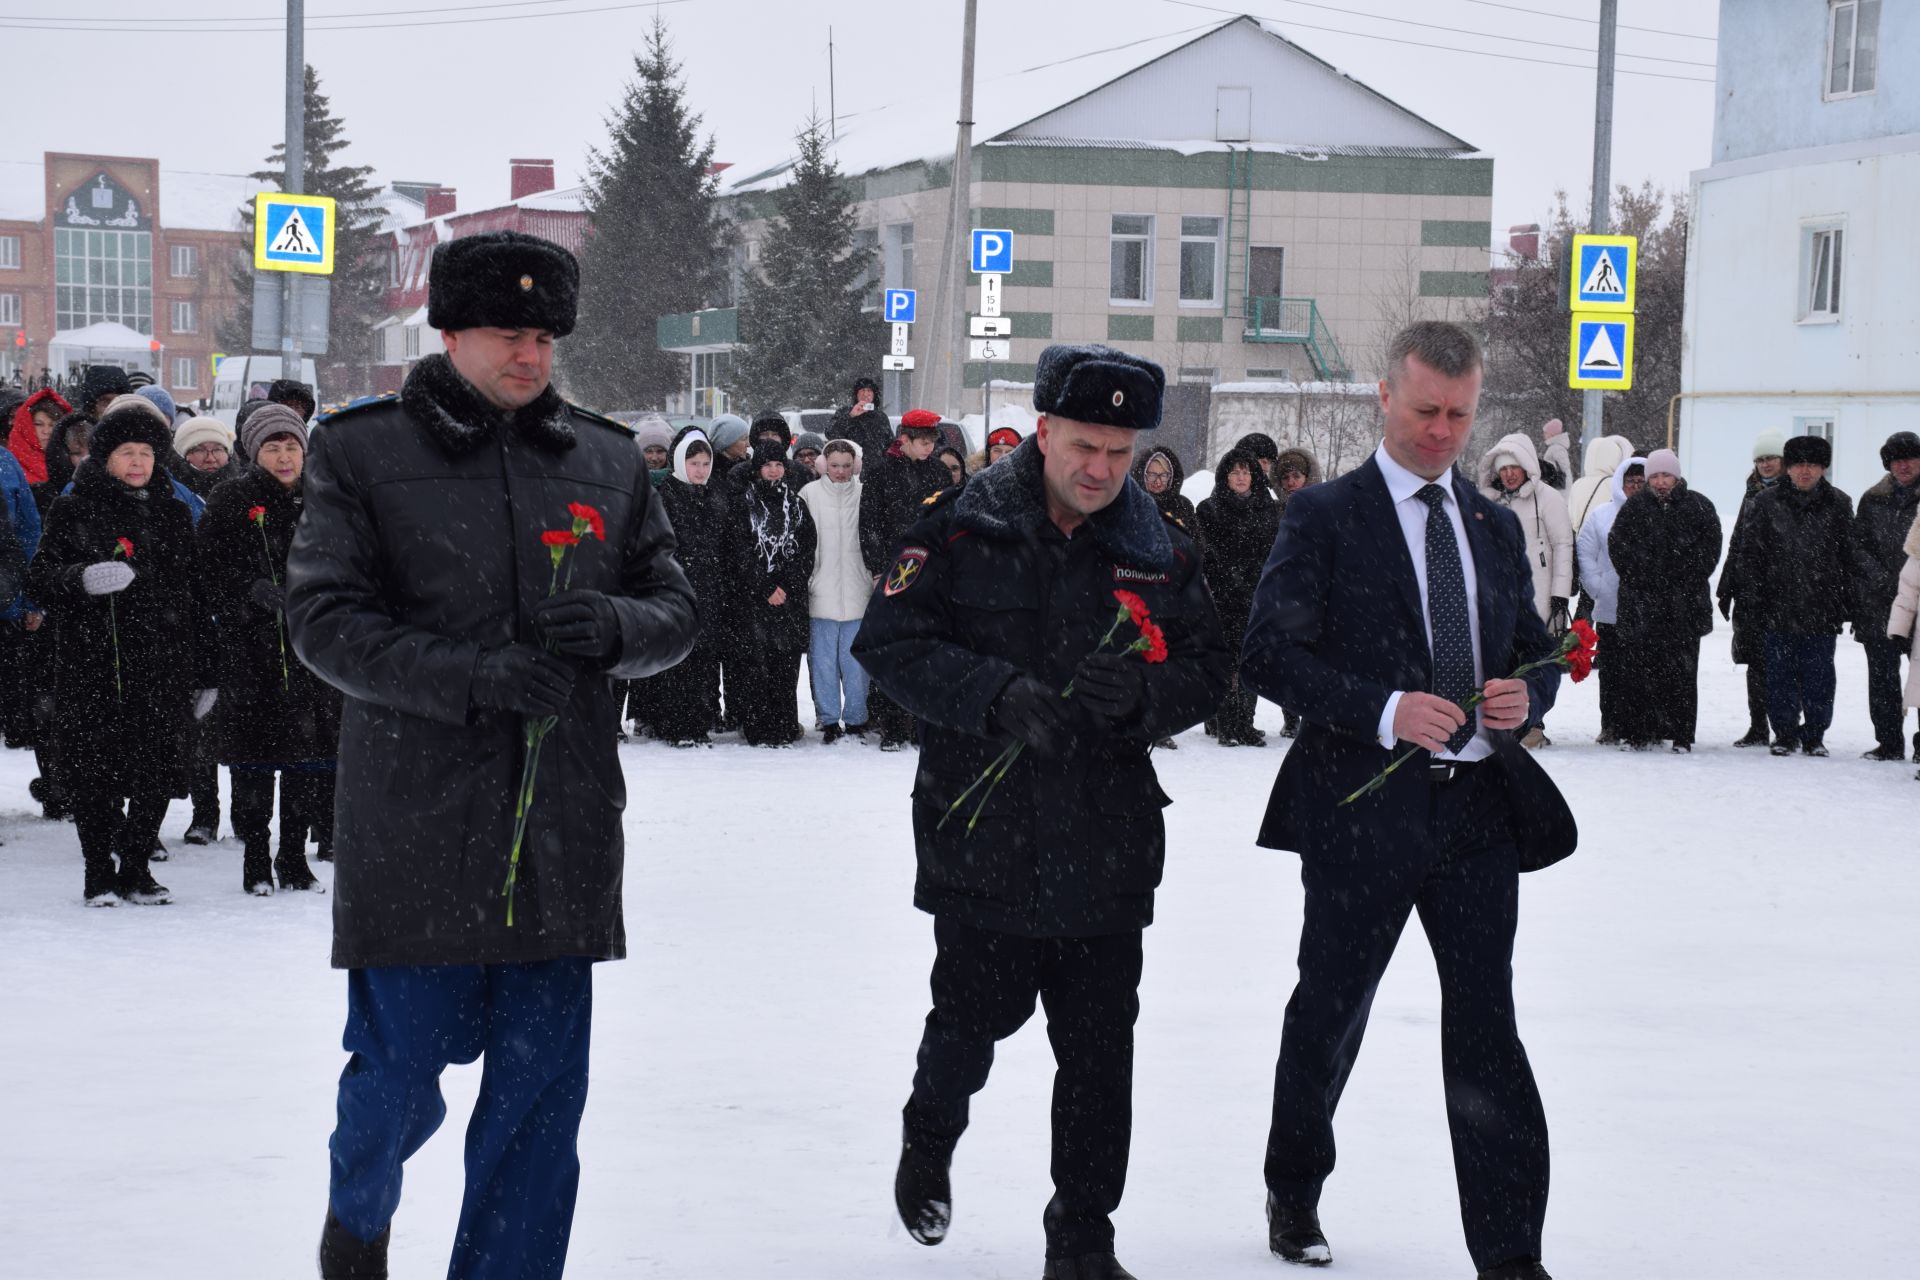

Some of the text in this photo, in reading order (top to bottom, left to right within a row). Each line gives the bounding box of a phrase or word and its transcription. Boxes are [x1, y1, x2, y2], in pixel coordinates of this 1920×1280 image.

[981, 234, 1004, 268] P
[892, 293, 909, 318] P
[987, 295, 995, 304] 15
